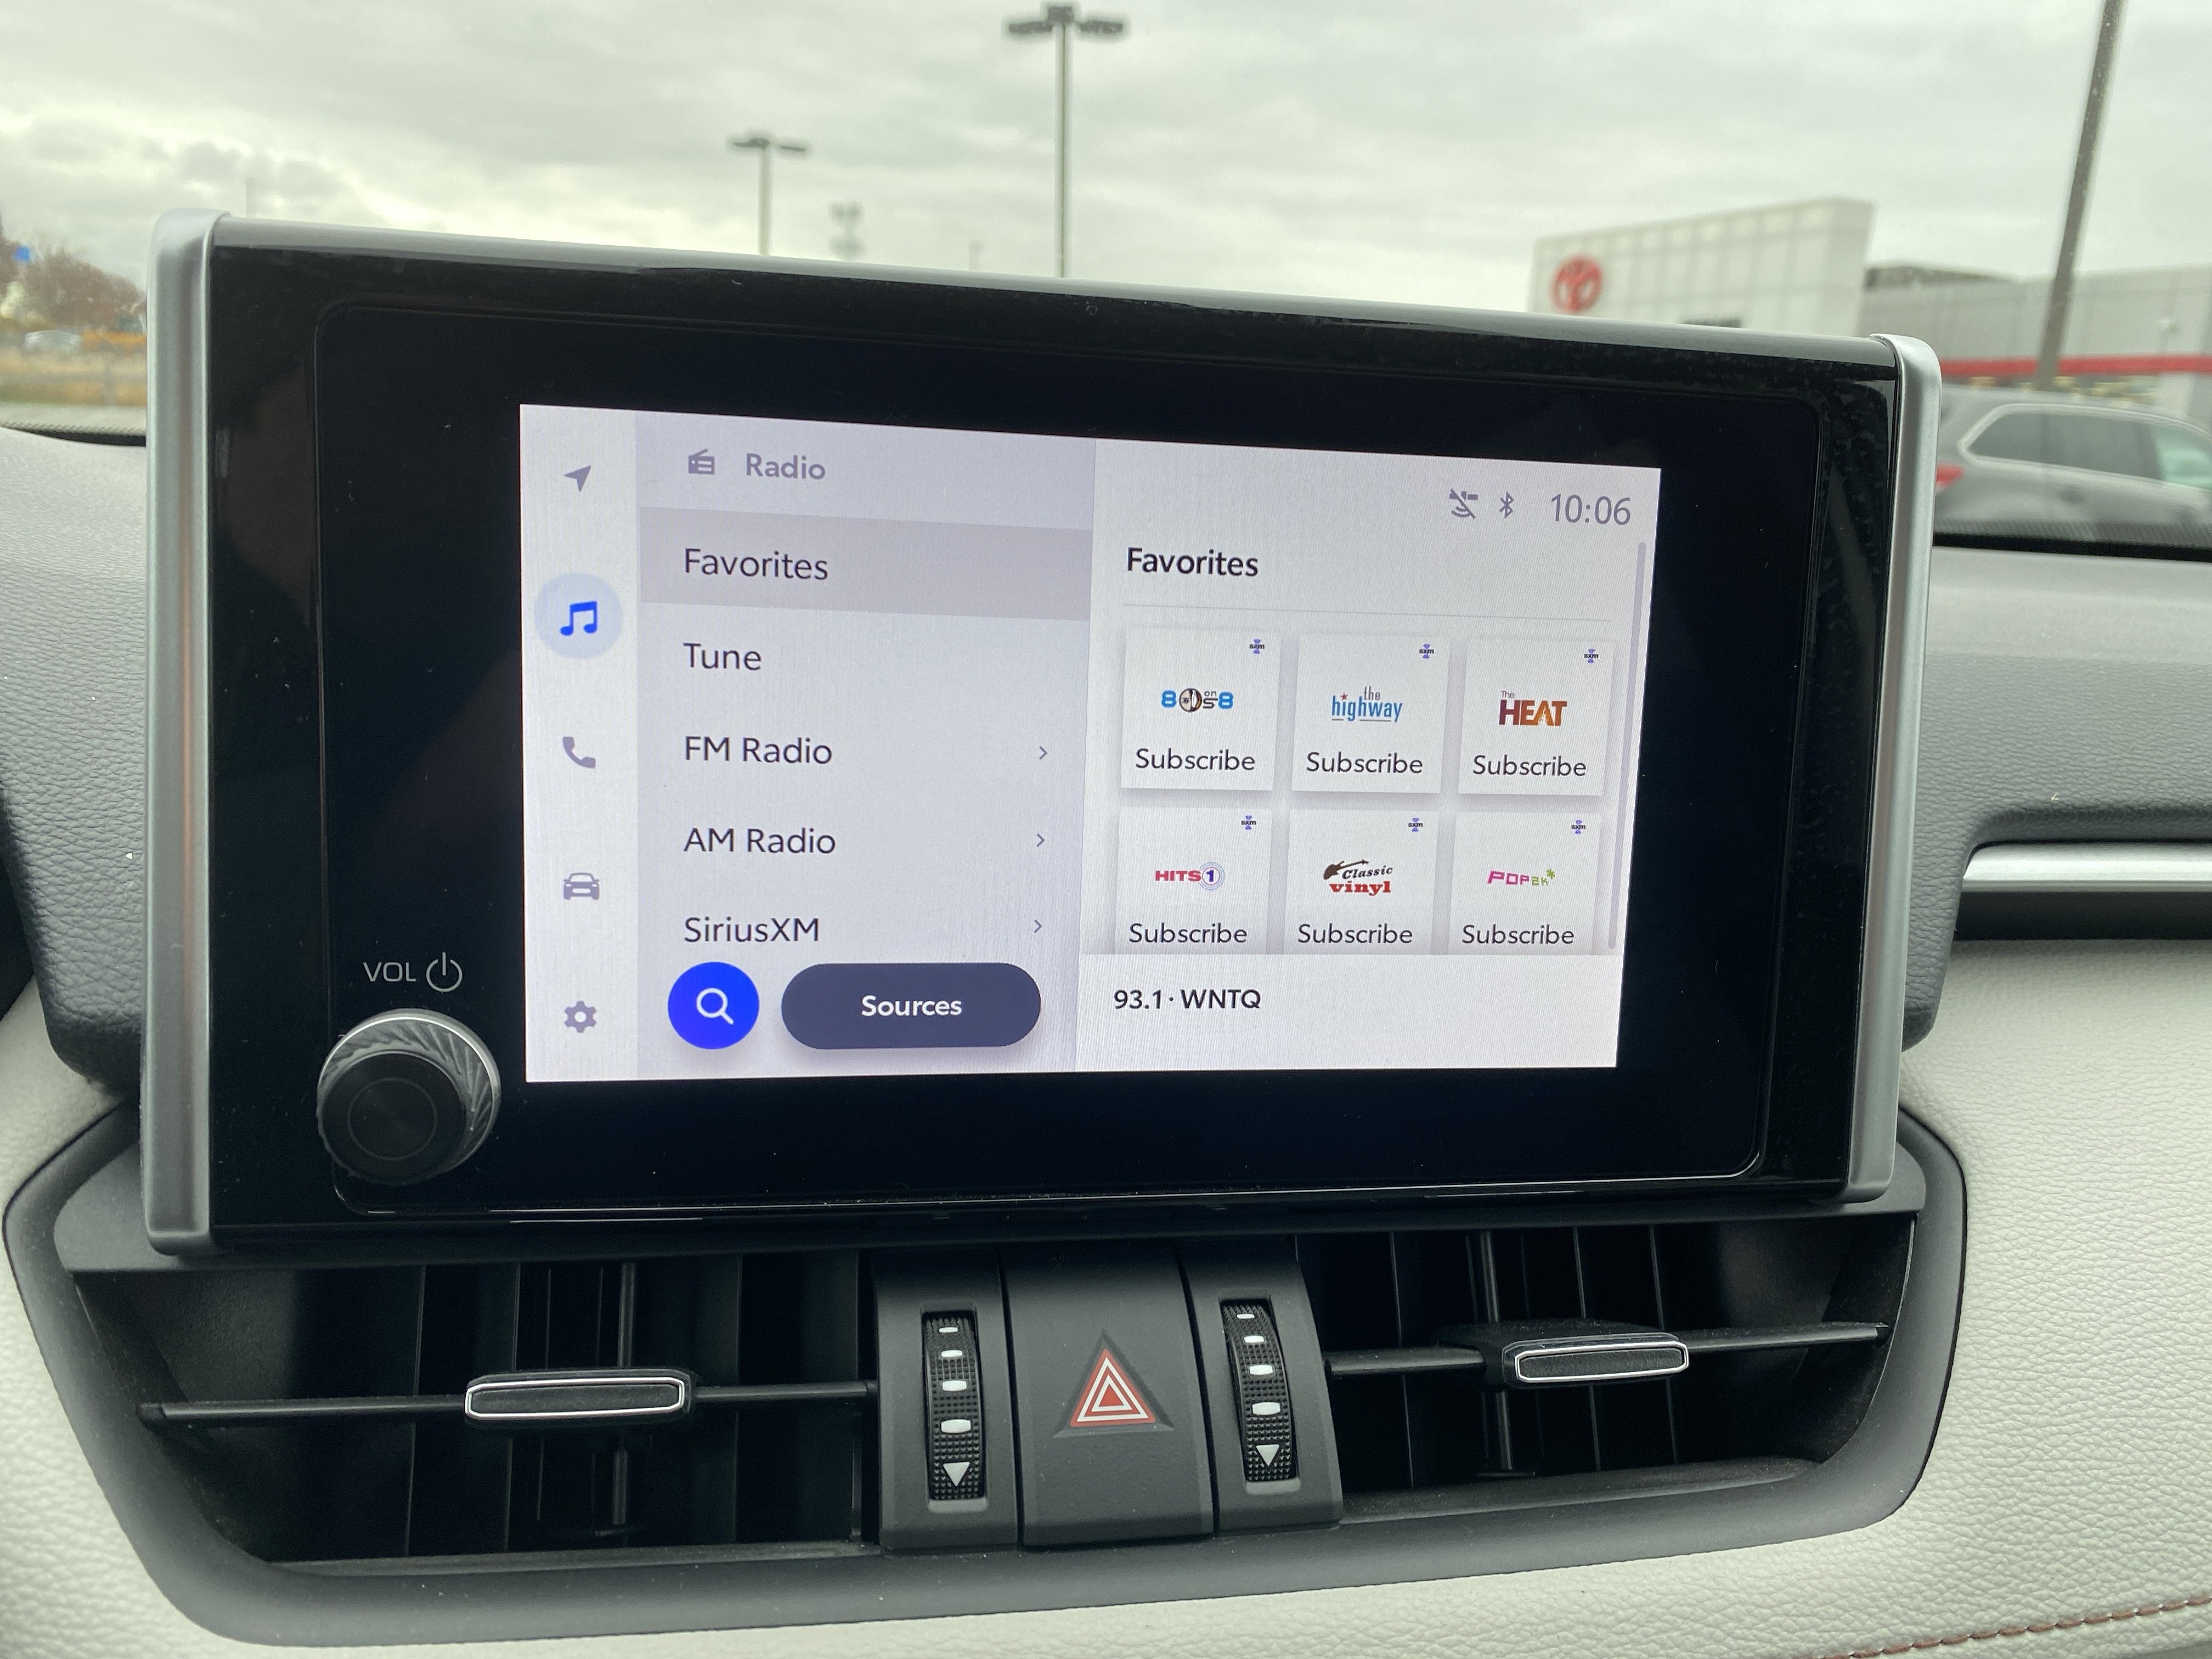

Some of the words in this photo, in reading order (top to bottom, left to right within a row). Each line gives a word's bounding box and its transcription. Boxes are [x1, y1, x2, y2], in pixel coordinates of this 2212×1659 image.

[745, 453, 826, 481] Radio
[1550, 494, 1632, 526] 10:06
[684, 548, 829, 581] Favorites
[1126, 546, 1259, 578] Favorites
[684, 642, 762, 671] Tune
[1364, 686, 1381, 701] the
[1501, 690, 1515, 698] The
[1331, 693, 1403, 723] highway
[1498, 699, 1567, 726] HEAT
[685, 736, 730, 763] FM
[742, 737, 832, 765] Radio
[1135, 747, 1255, 771] Subscribe
[1306, 751, 1423, 774] Subscribe
[1472, 754, 1587, 776] Subscribe
[684, 827, 735, 853] AM
[746, 827, 836, 854] Radio
[1155, 870, 1202, 882] HITS
[1206, 870, 1214, 882] 1
[1342, 865, 1393, 879] Classic
[1329, 881, 1391, 896] vinyl
[684, 917, 820, 943] SiriusXM
[1129, 922, 1248, 943] Subscribe
[1298, 923, 1413, 944] Subscribe
[1462, 924, 1575, 944] Subscribe
[363, 961, 417, 982] VOL
[861, 995, 962, 1018] Sources
[1114, 989, 1161, 1009] 93.1
[1180, 989, 1261, 1009] WNTQ
